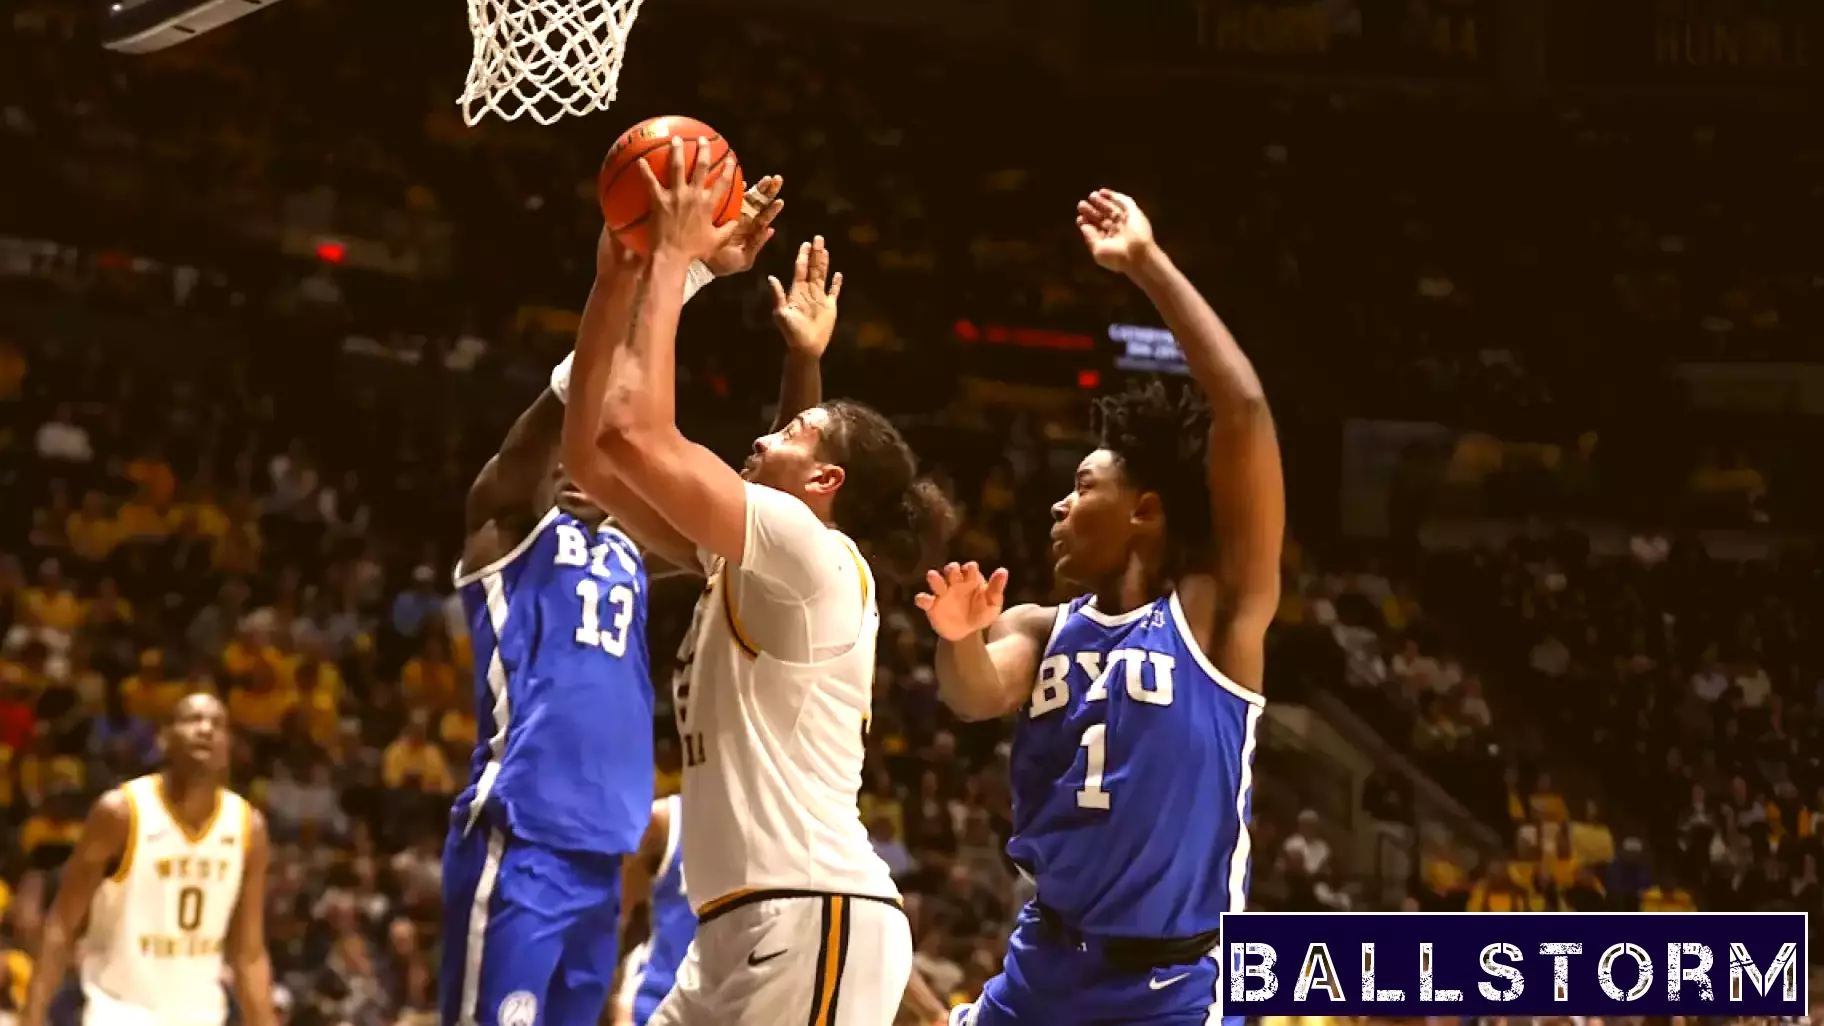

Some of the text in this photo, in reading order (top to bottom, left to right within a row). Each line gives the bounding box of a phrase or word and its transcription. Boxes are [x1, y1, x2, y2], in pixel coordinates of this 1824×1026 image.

[575, 578, 633, 657] 13
[1029, 648, 1176, 710] BYU
[1077, 723, 1111, 810] 1
[179, 887, 204, 931] 0
